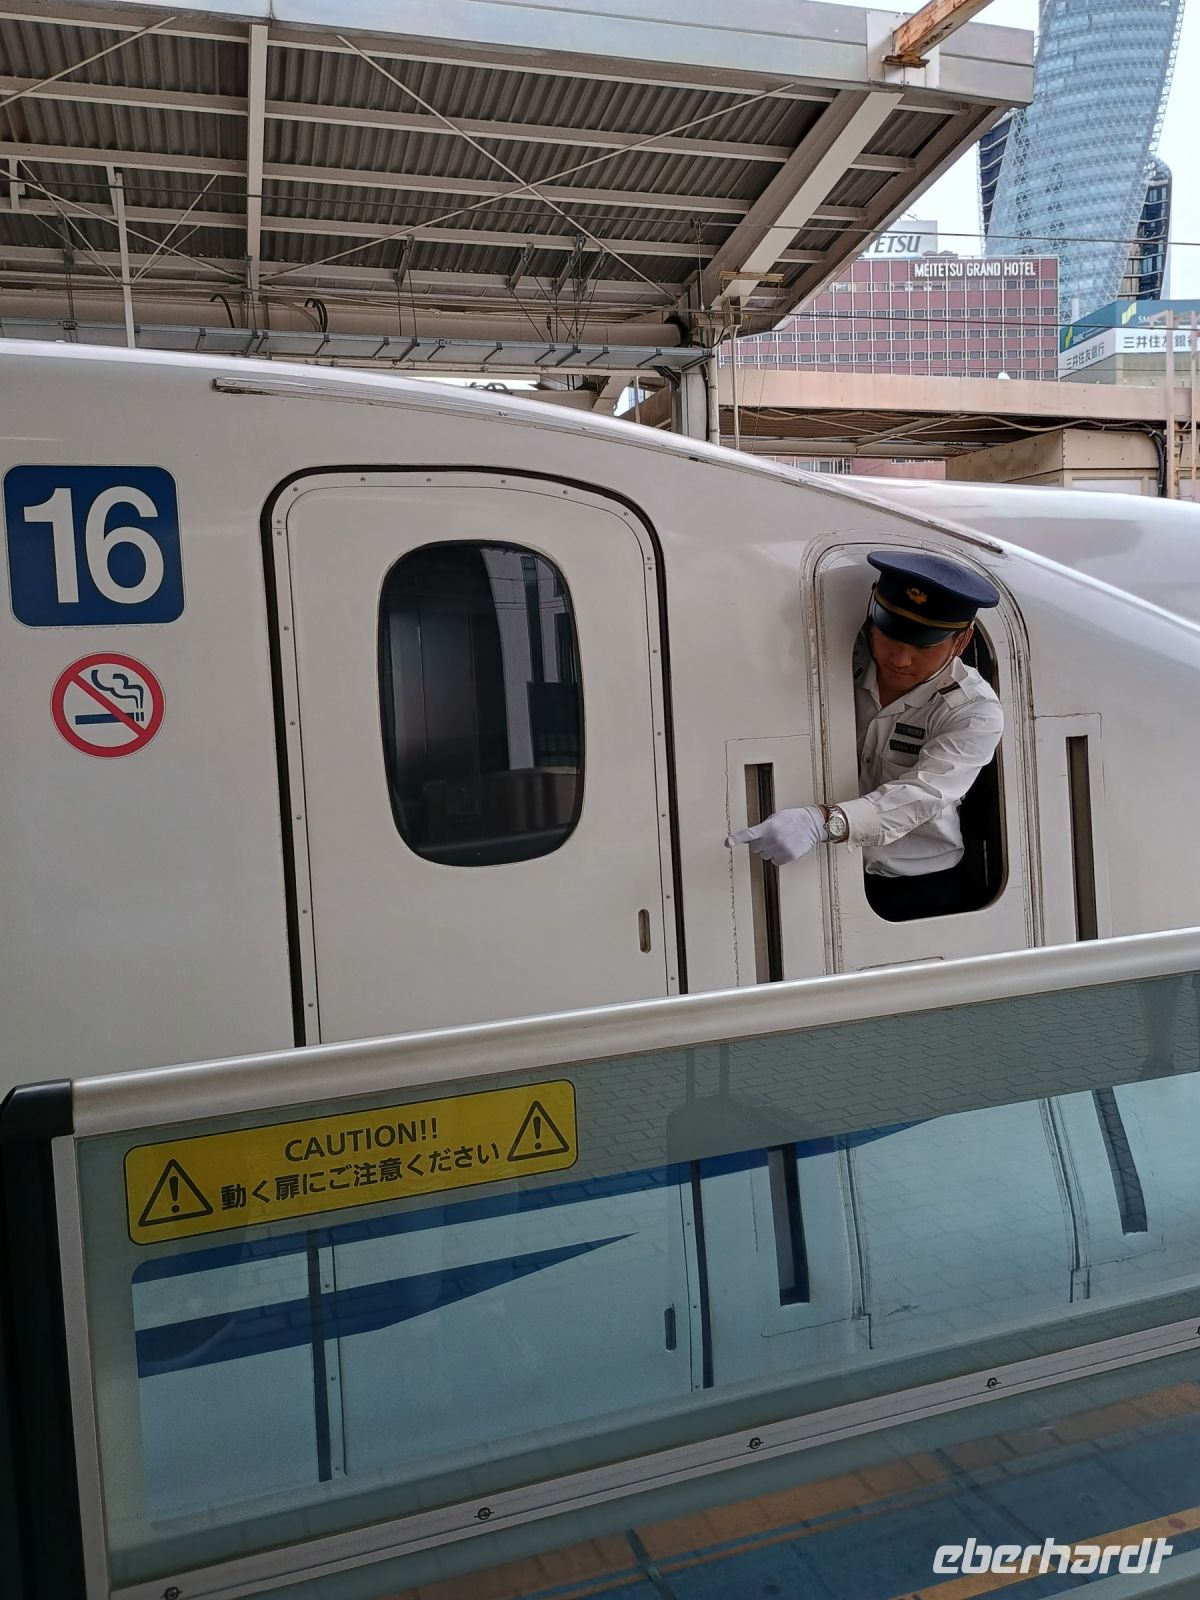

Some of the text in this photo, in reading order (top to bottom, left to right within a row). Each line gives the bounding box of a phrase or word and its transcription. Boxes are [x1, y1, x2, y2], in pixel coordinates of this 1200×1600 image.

[914, 261, 1037, 277] MEITETSU GRAND HOTEL
[1066, 342, 1105, 369] 三井住友銀行
[23, 485, 165, 605] 16
[284, 1117, 438, 1162] CAUTION!!
[220, 1142, 500, 1211] 動く扉にご注意ください
